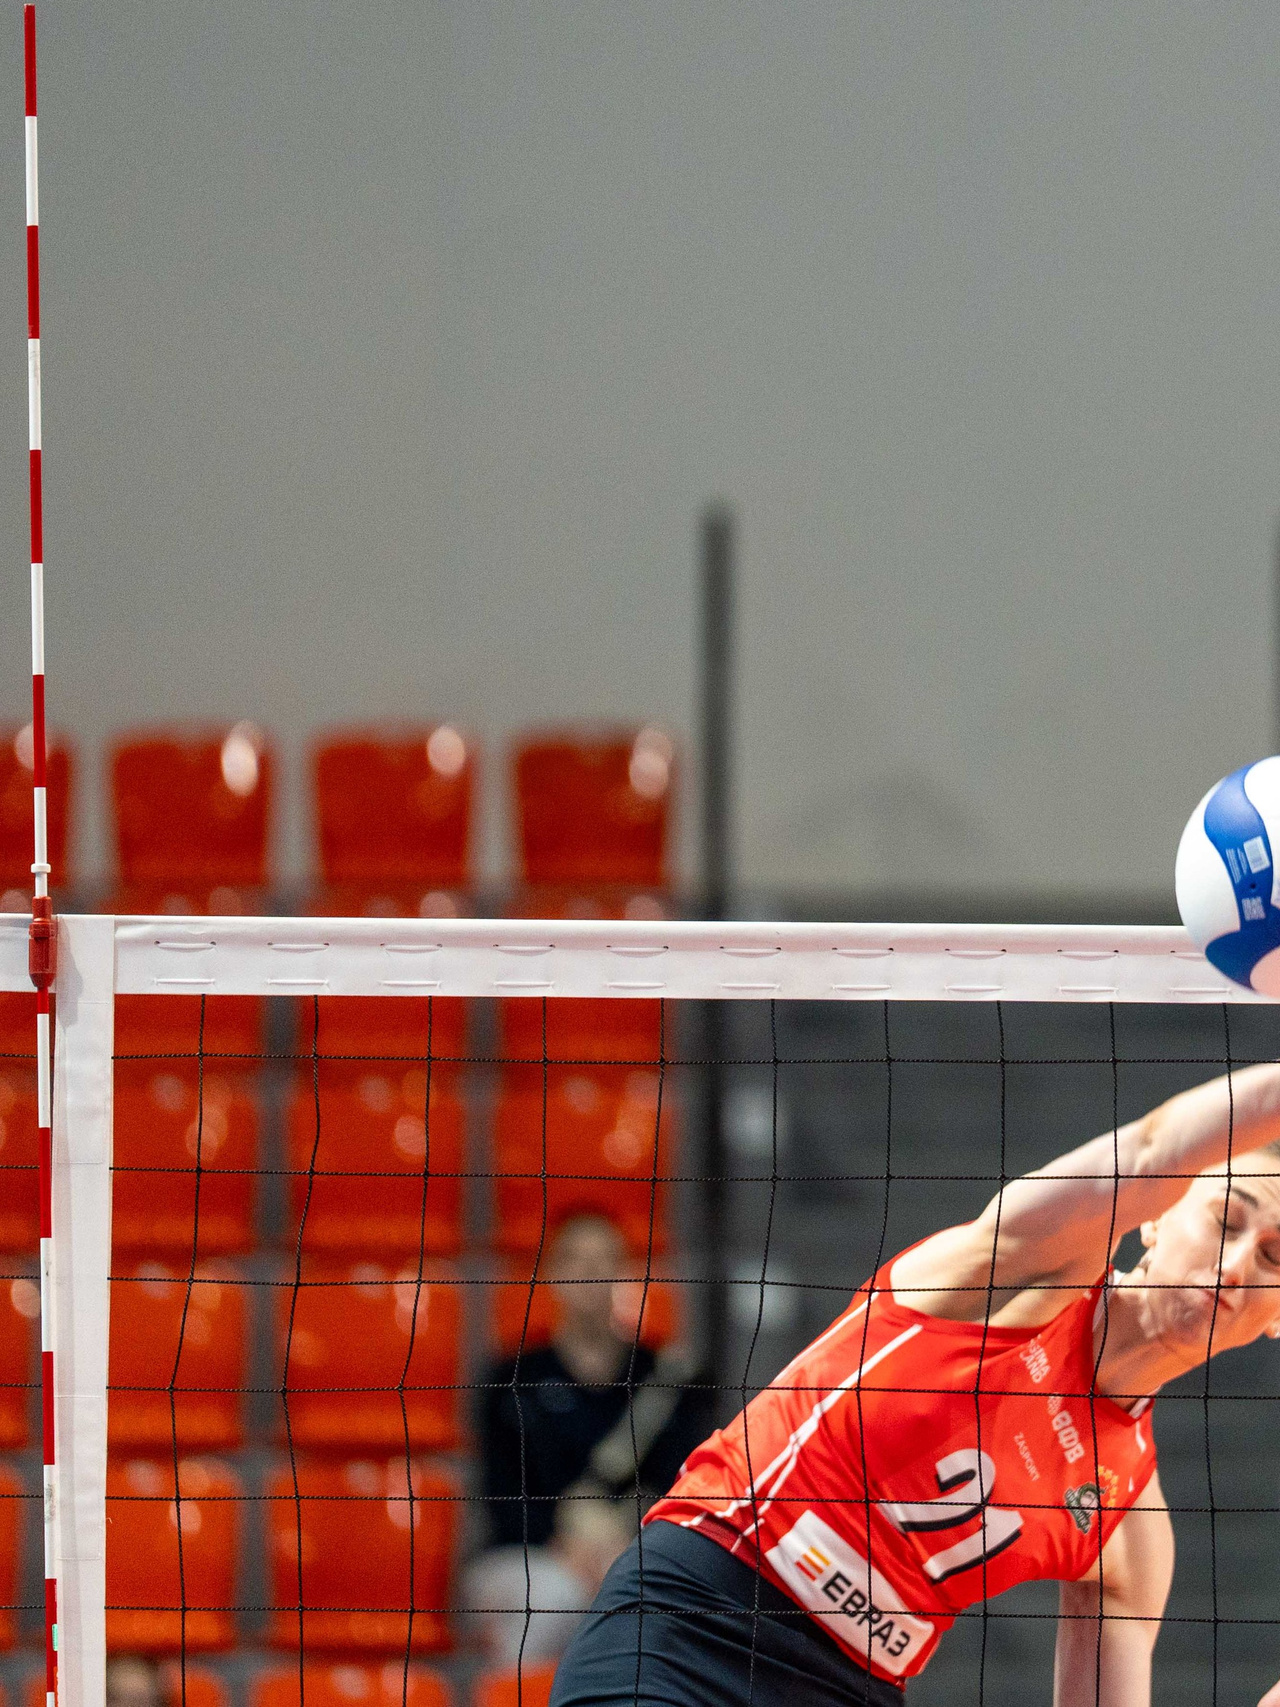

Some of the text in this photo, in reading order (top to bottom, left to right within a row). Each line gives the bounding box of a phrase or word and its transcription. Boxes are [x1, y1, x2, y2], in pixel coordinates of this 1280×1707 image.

[1013, 1431, 1041, 1482] ZASPORT
[877, 1447, 1024, 1584] 21
[821, 1570, 911, 1657] ЕВРАЗ
